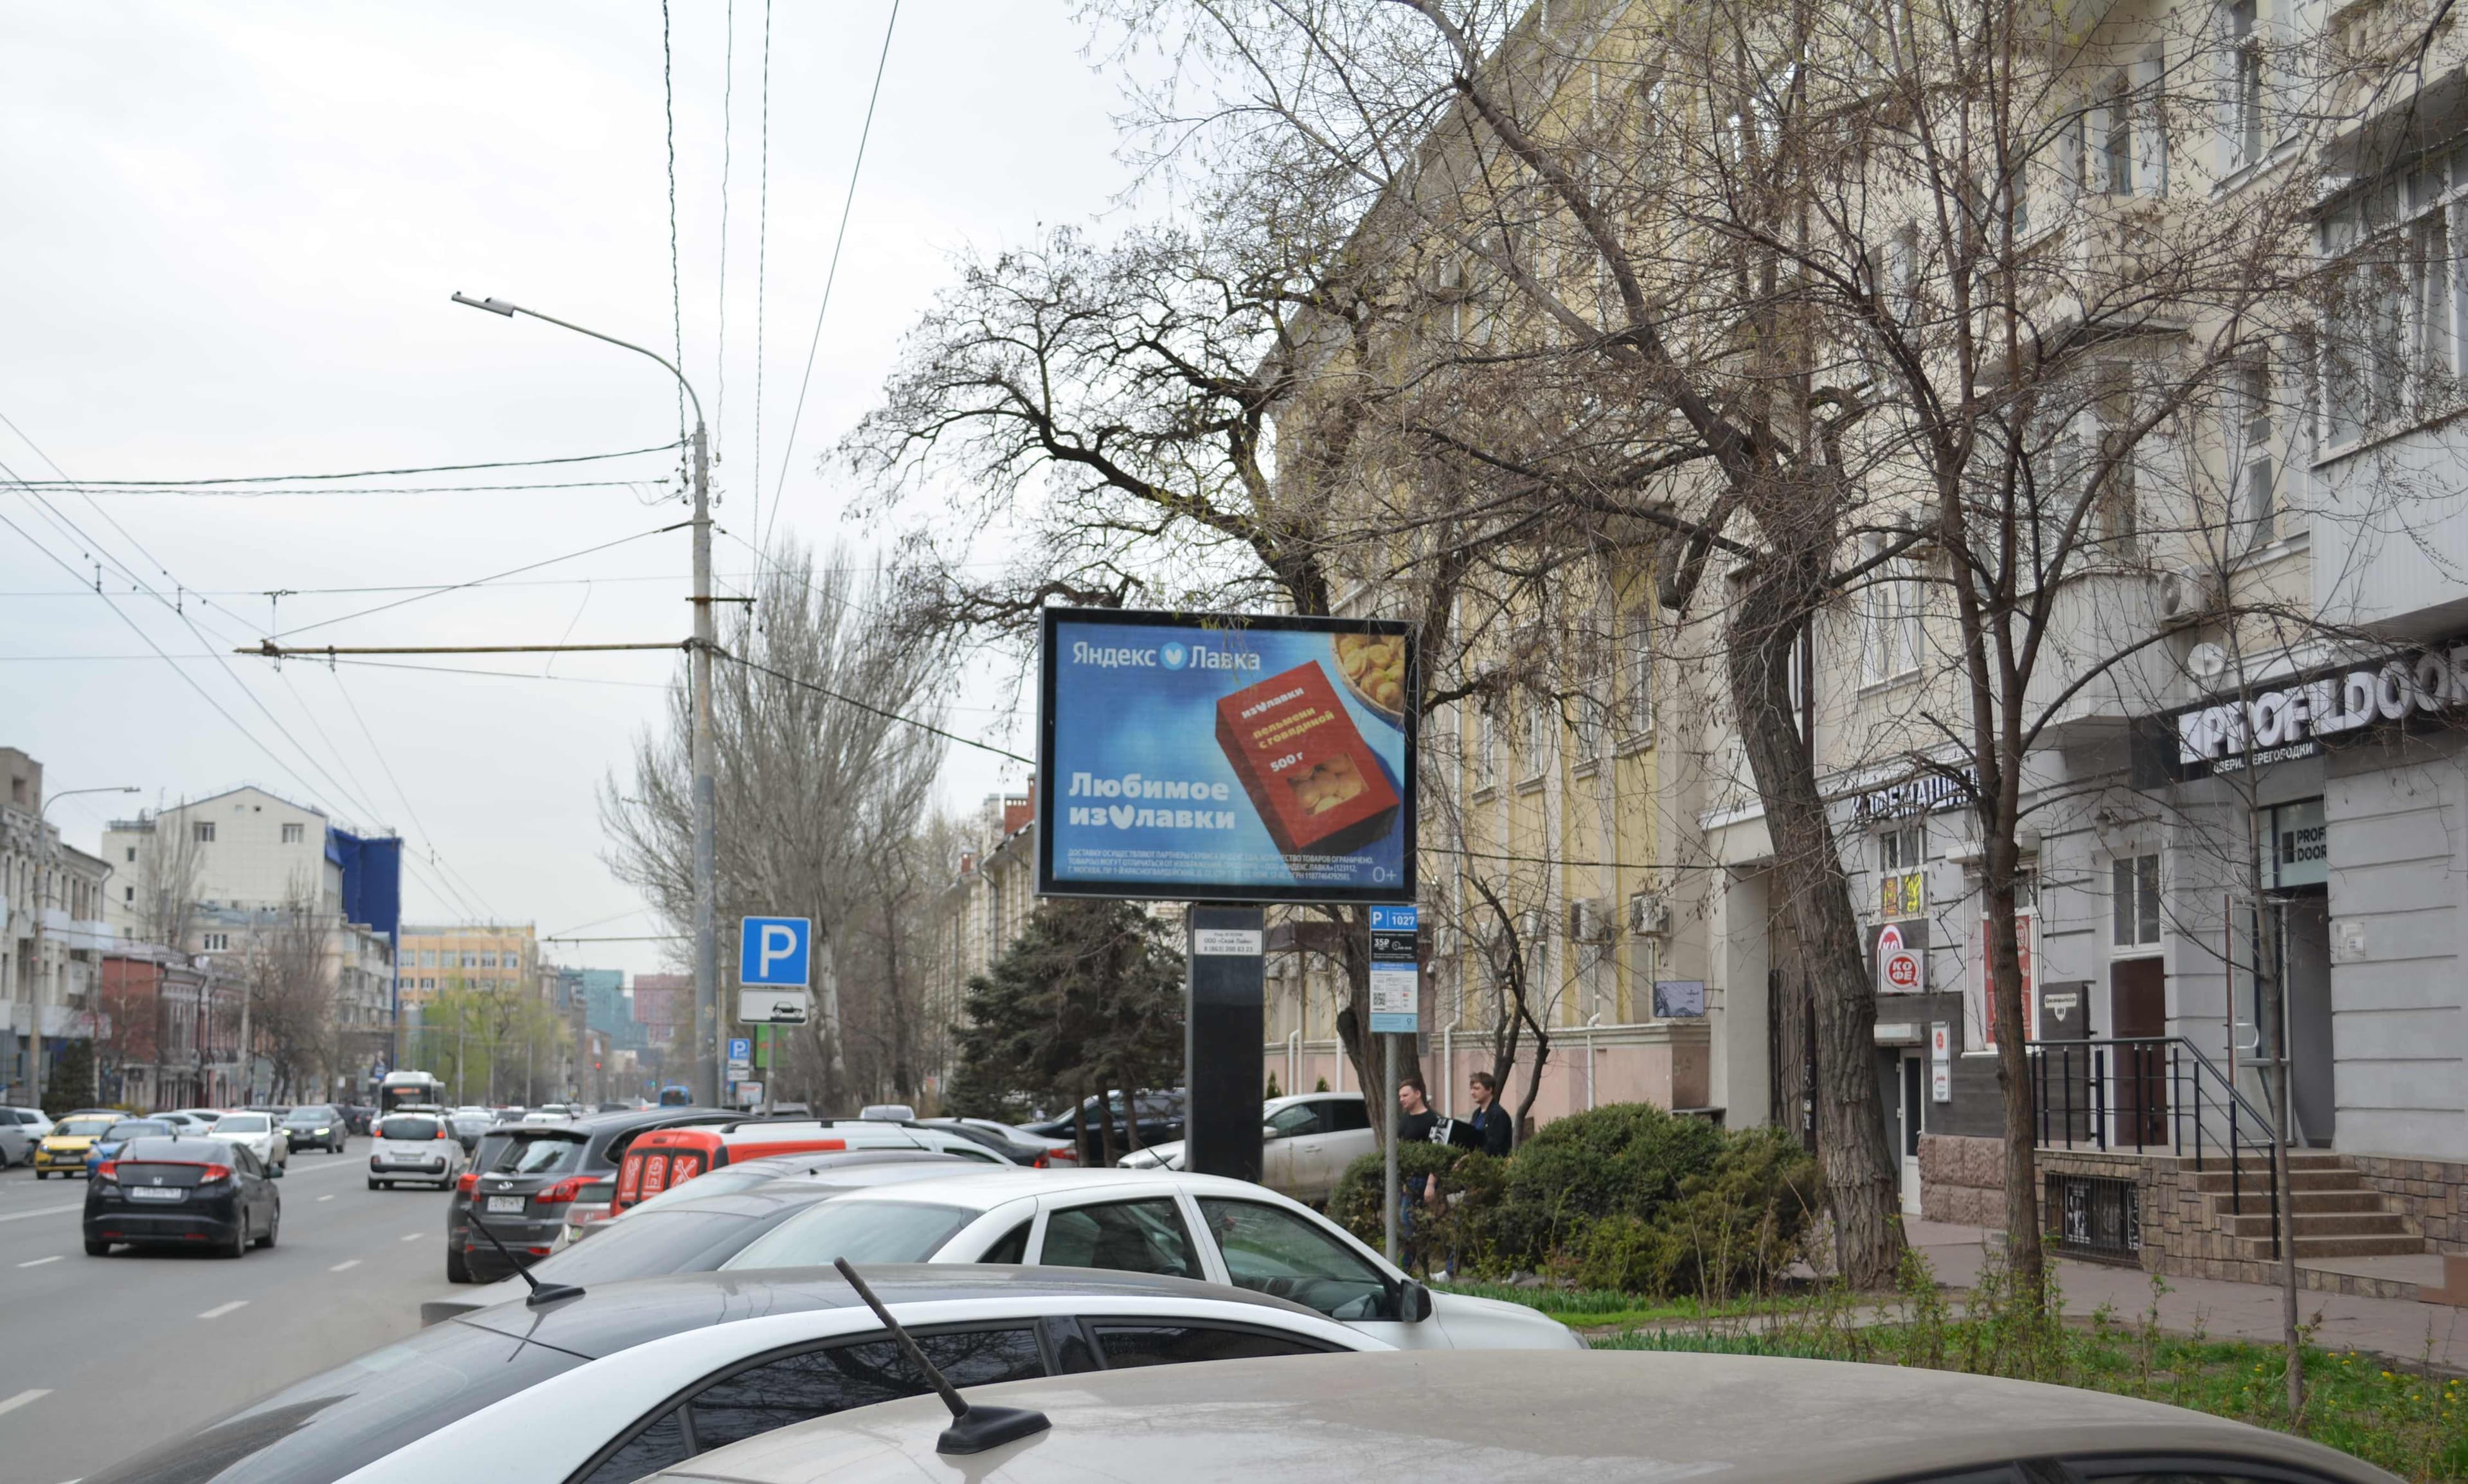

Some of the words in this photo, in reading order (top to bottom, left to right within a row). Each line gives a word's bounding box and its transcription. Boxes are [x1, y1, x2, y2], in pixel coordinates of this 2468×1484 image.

[1073, 641, 1156, 668] Яндекс
[1190, 645, 1260, 670] Лавка
[1253, 707, 1316, 738] пельмени
[1267, 710, 1335, 746] говядиной
[1270, 755, 1296, 772] 500
[1296, 752, 1303, 761] г
[2248, 742, 2313, 765] ЕРЕГОРОДКИ
[1069, 772, 1230, 801] Любимое
[1303, 855, 1331, 863] ТОВАРОВ
[1332, 855, 1374, 864] ОГРАНИЧЕНО.
[1372, 866, 1397, 883] 0+
[1372, 911, 1382, 925] P
[1391, 915, 1415, 926] 1027
[759, 924, 798, 978] P
[1892, 961, 1913, 970] КО
[1892, 970, 1913, 981] ФЕ
[733, 1041, 746, 1057] P
